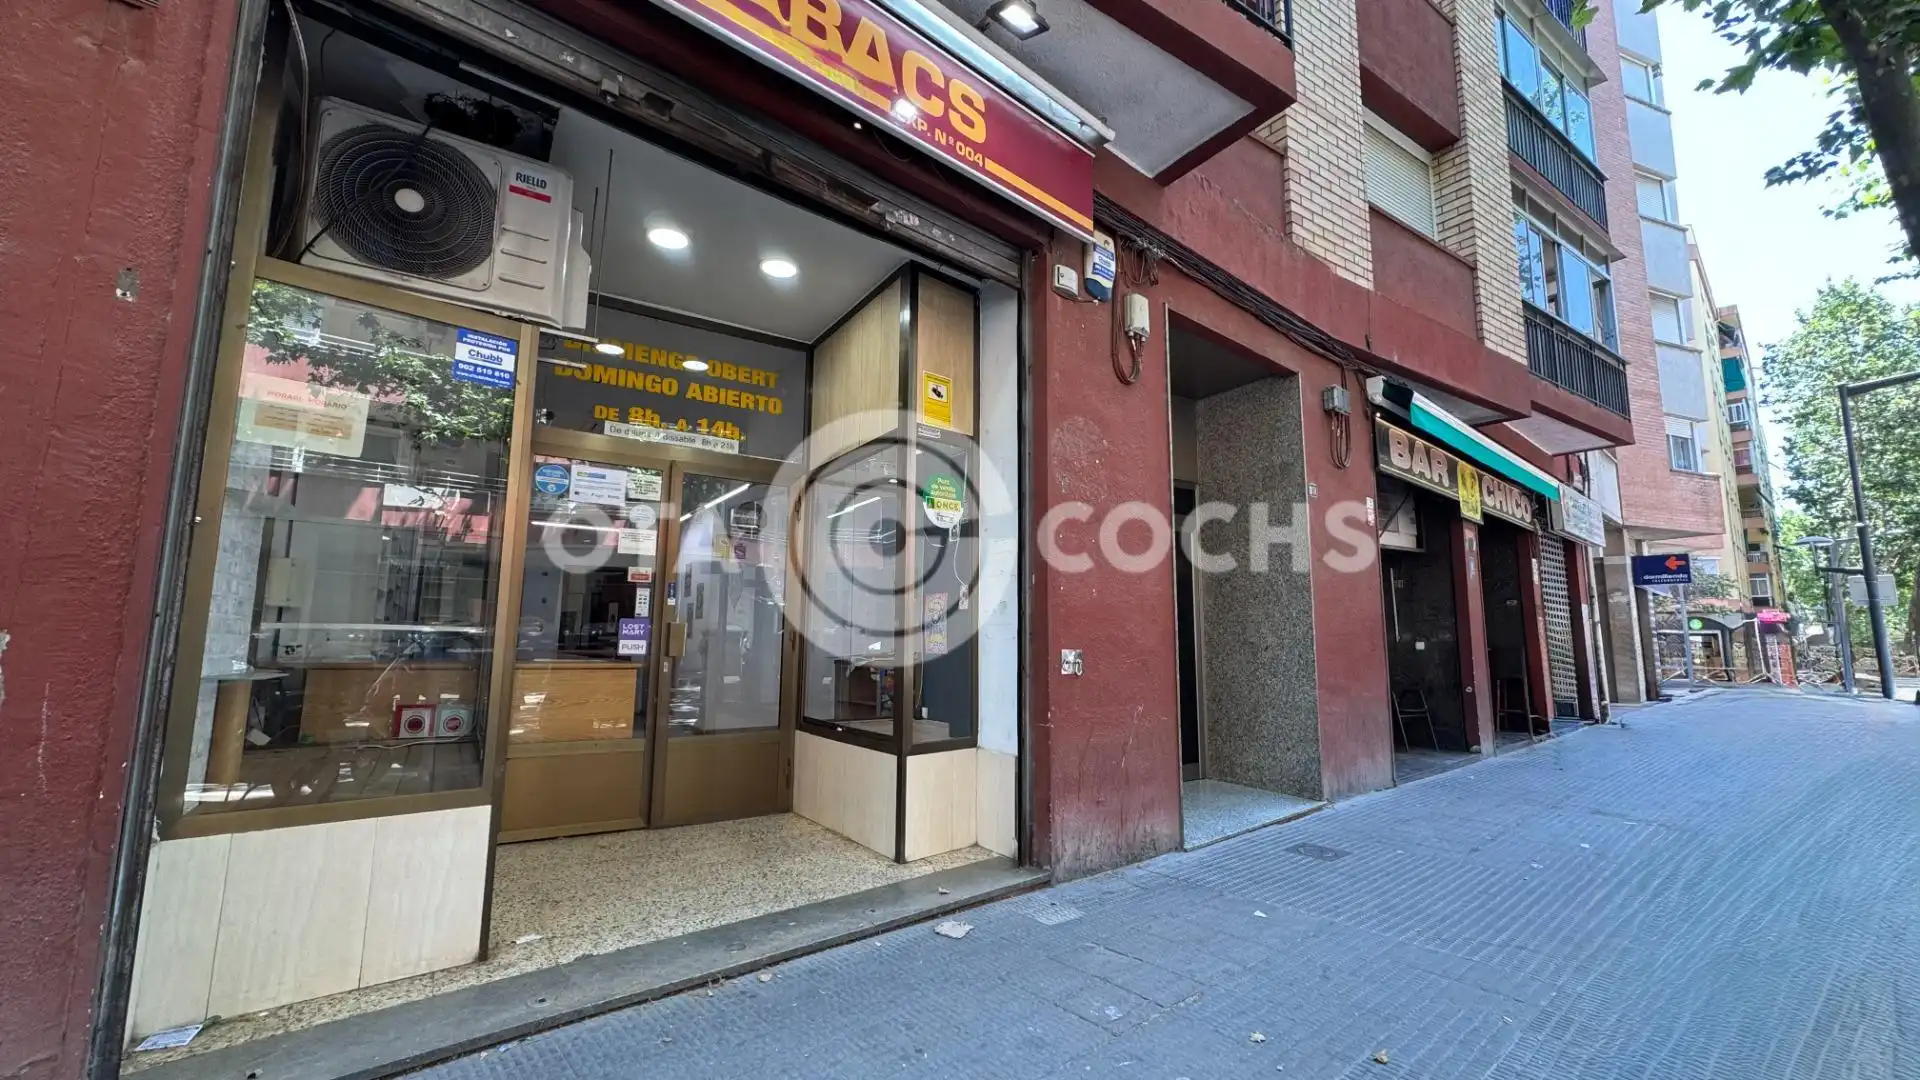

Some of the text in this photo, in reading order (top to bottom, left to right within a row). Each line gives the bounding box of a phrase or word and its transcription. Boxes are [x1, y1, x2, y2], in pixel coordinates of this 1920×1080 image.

[748, 0, 987, 144] BACS
[954, 141, 985, 167] 004
[515, 171, 548, 190] RIELLO
[468, 348, 503, 363] Chubb
[706, 359, 779, 389] OBERT
[553, 360, 783, 415] DOMINGO ABIERTO
[593, 404, 620, 421] DE
[1388, 427, 1450, 488] BAR
[1481, 474, 1533, 523] CHICO
[935, 500, 960, 511] ONCE
[621, 643, 644, 652] PUSH
